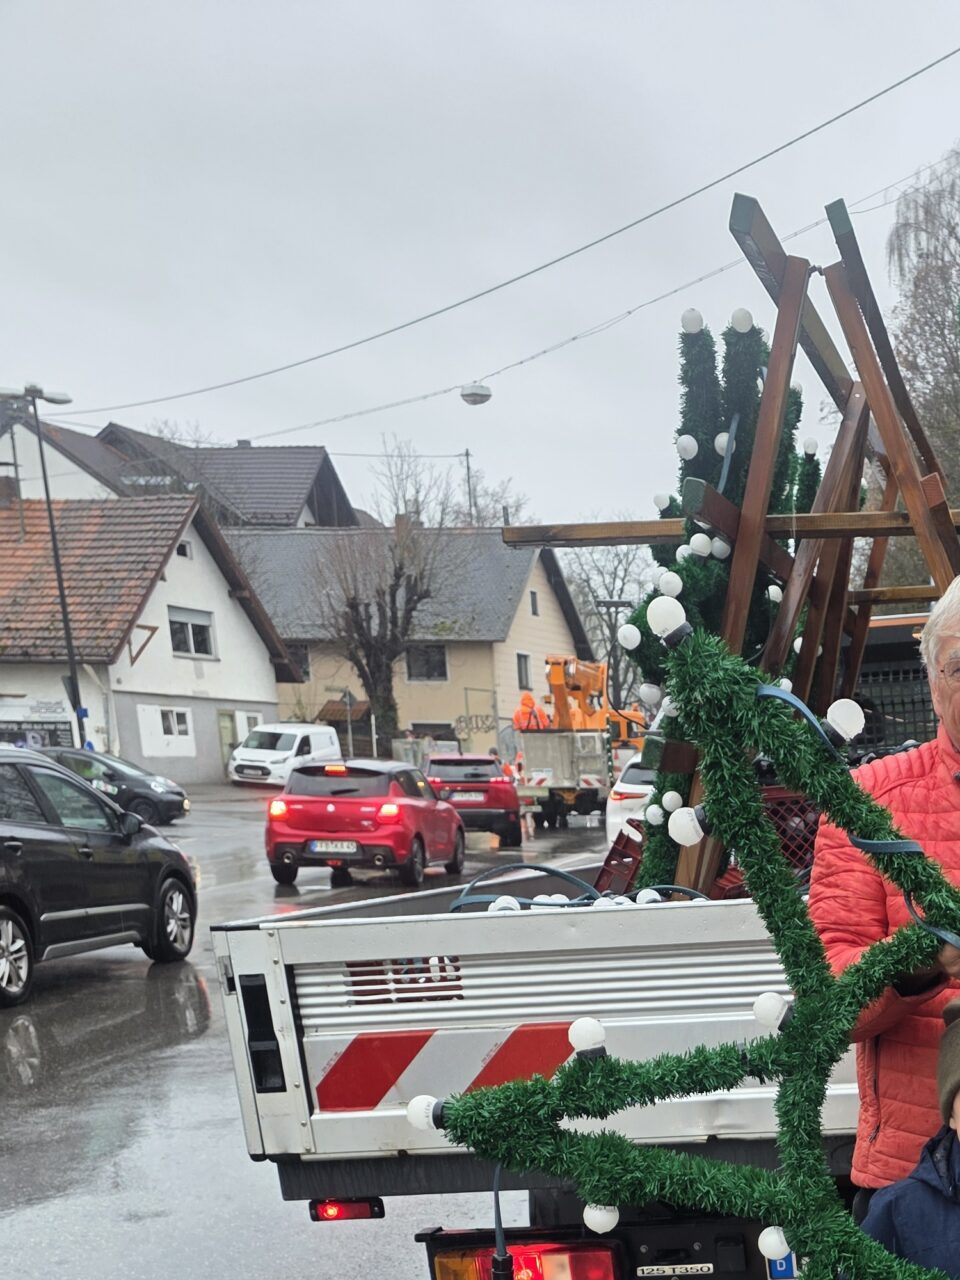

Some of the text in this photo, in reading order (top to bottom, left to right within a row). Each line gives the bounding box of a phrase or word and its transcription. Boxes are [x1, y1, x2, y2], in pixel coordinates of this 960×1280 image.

[639, 1265, 711, 1276] 125 T350
[776, 1259, 786, 1271] D
